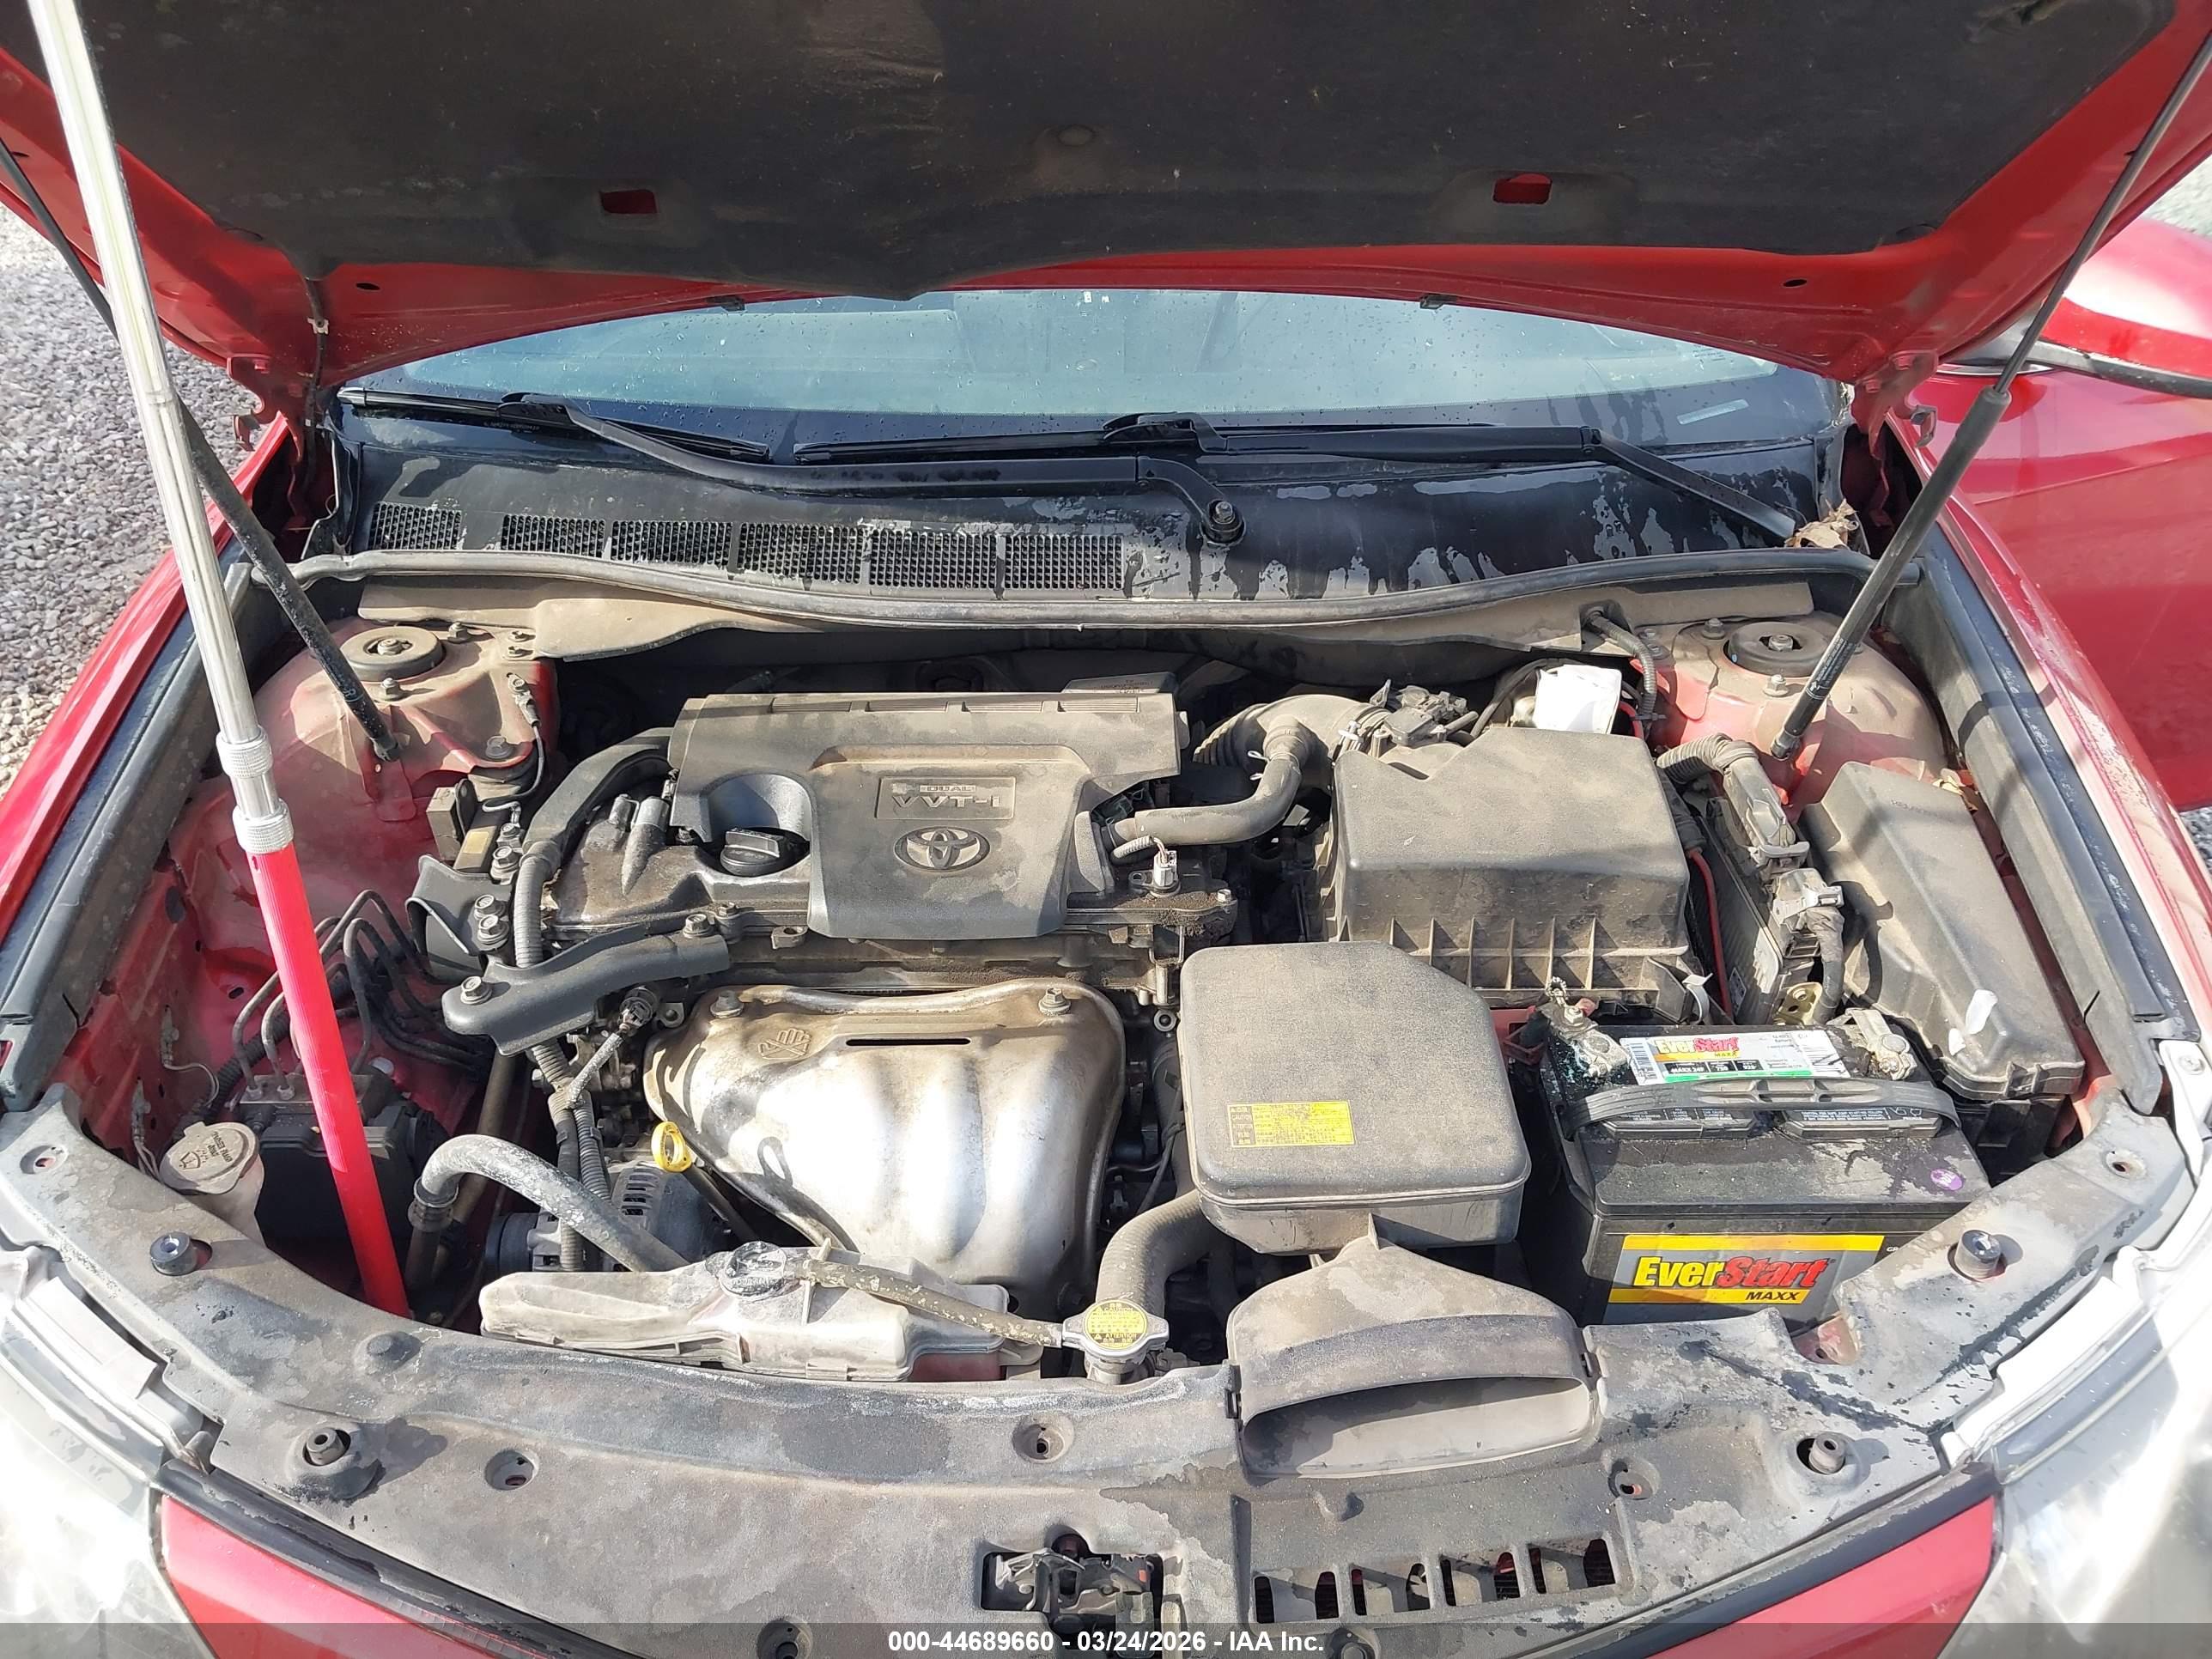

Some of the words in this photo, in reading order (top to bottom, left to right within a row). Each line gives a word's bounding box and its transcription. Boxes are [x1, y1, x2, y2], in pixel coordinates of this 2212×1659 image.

[1655, 1037, 1740, 1054] EverStart
[1633, 1256, 1828, 1288] EverStart
[1745, 1291, 1801, 1302] MAXX
